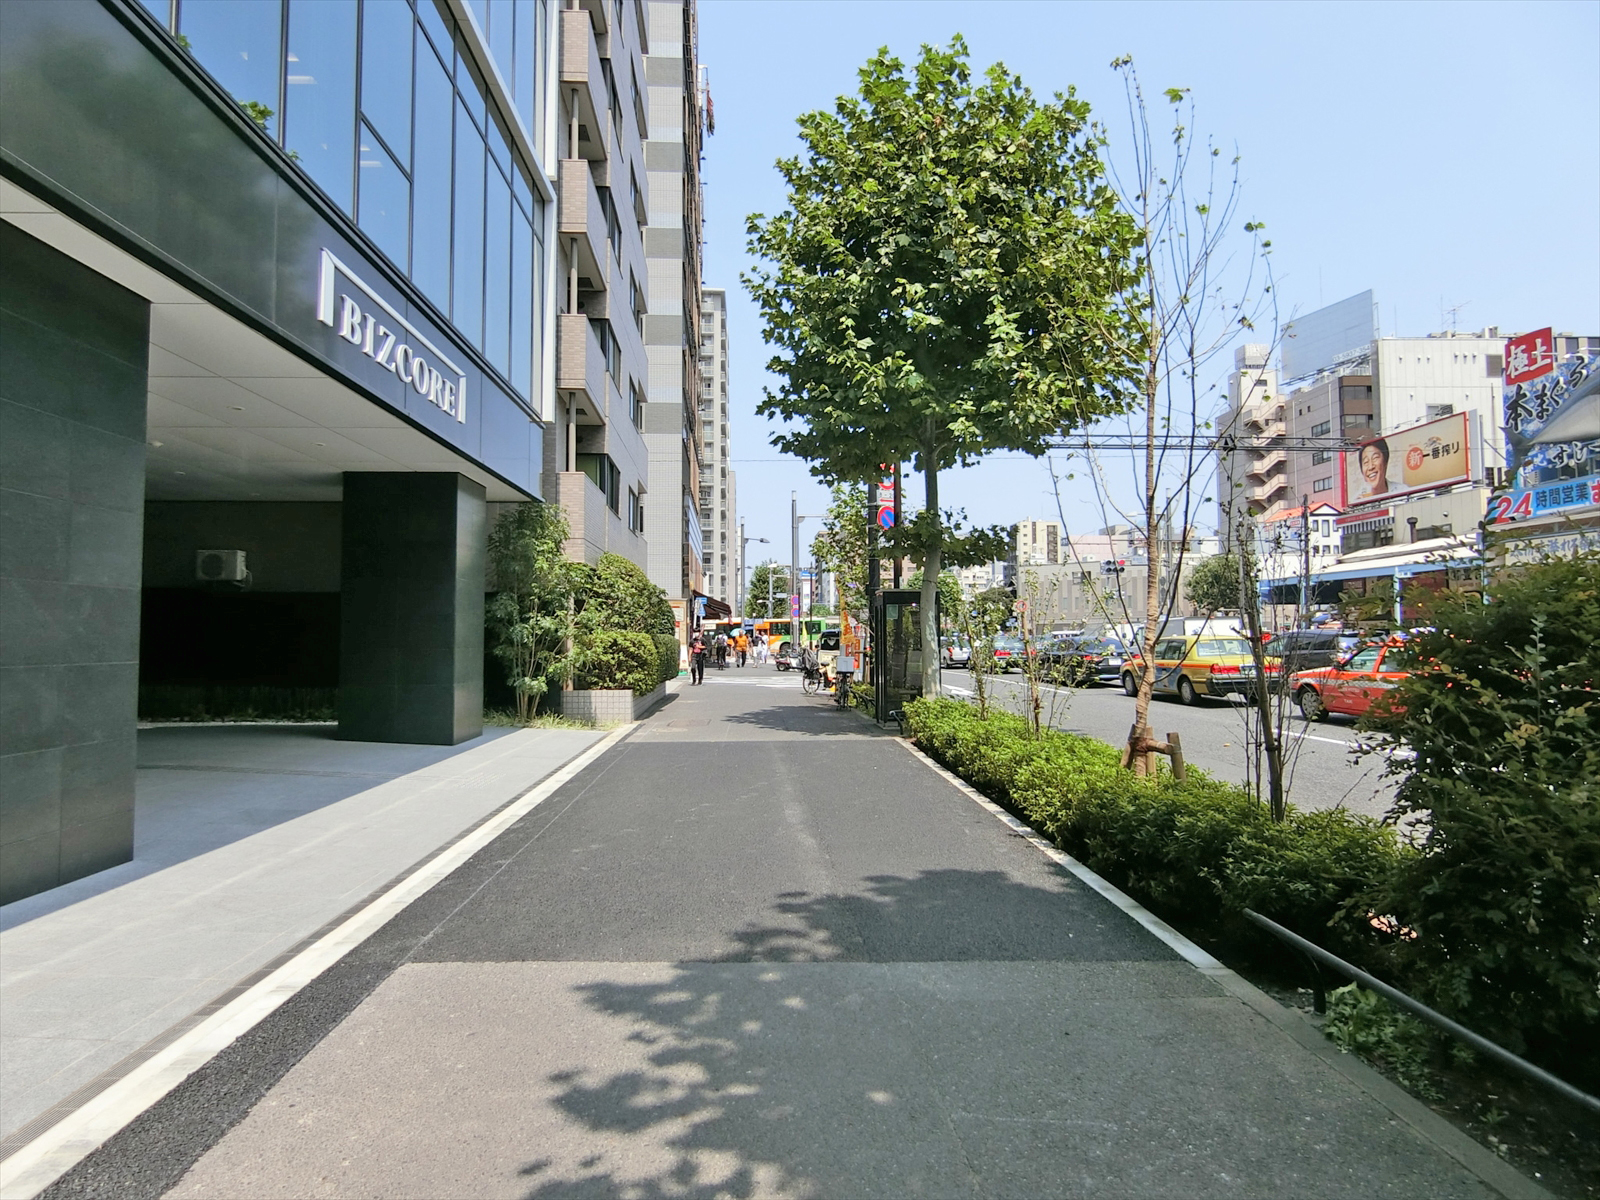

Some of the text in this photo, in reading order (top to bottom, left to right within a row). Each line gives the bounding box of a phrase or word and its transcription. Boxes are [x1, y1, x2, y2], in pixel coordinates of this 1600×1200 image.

[338, 294, 455, 417] BIZCORE
[1507, 338, 1551, 379] 極上
[1505, 354, 1588, 433] 本まぐろ
[1409, 441, 1459, 467] 新 一番搾り
